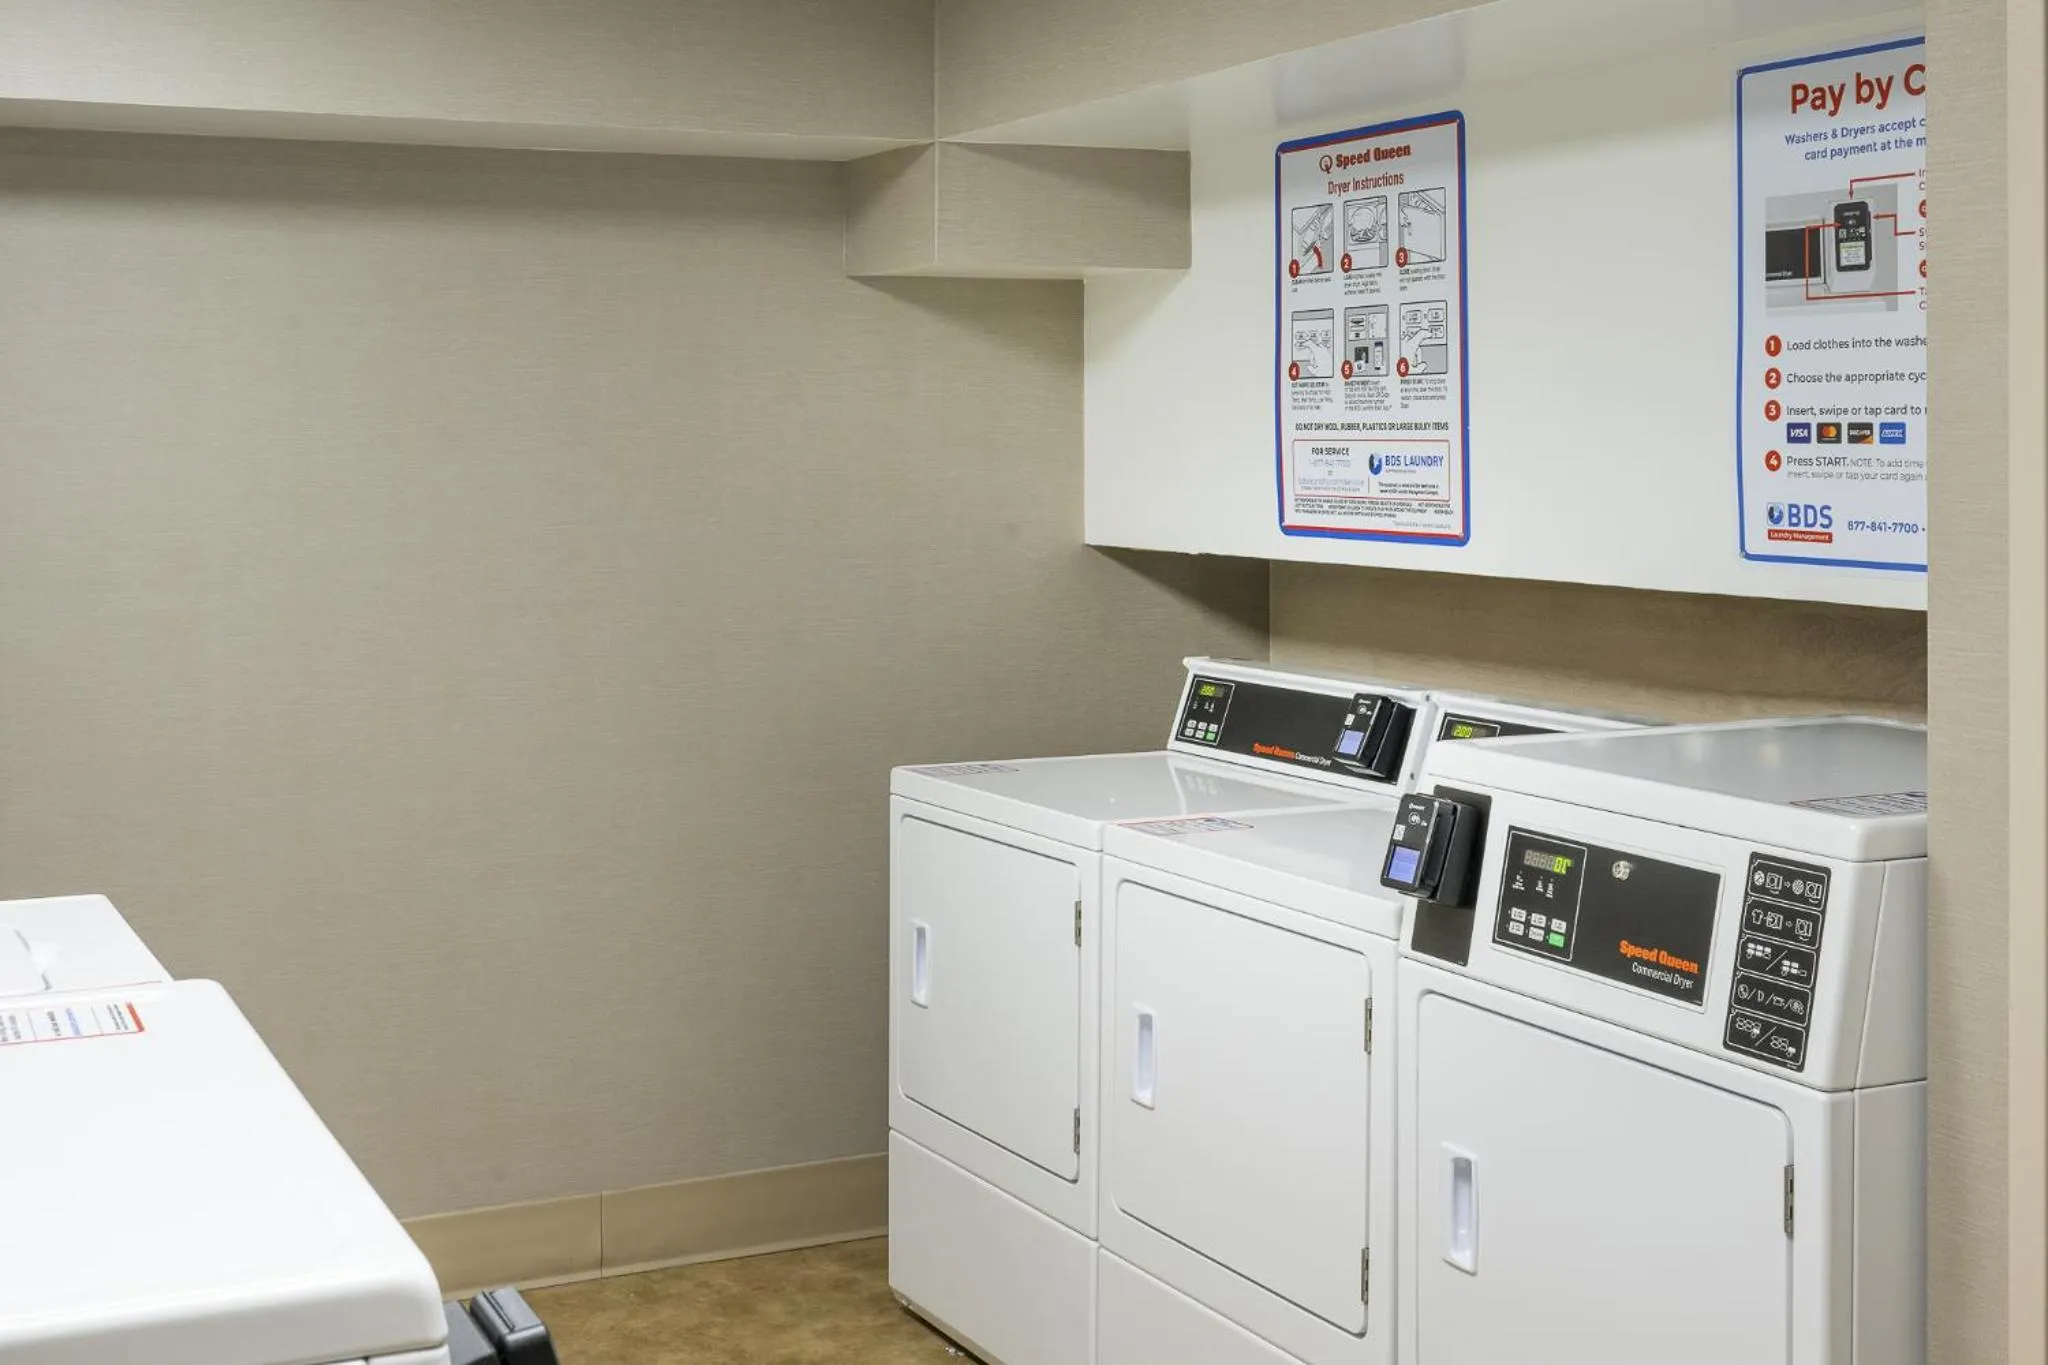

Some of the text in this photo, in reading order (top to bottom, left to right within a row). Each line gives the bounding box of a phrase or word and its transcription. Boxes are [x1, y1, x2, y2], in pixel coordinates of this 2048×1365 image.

[1791, 82, 1846, 117] Pay
[1855, 72, 1894, 110] by
[1784, 131, 1829, 146] Washers
[1830, 128, 1838, 139] &
[1841, 124, 1876, 139] Dryers
[1878, 117, 1917, 132] accept
[1804, 147, 1828, 161] card
[1830, 143, 1877, 160] payment
[1880, 140, 1892, 151] at
[1895, 136, 1913, 149] the
[1335, 149, 1371, 170] Speed
[1373, 144, 1411, 163] Queen
[1327, 172, 1405, 197] Dryer Instructions
[1787, 340, 1811, 351] Load
[1813, 338, 1850, 350] clothes
[1852, 338, 1872, 349] into
[1875, 336, 1892, 347] the
[1787, 373, 1823, 384] Choose
[1825, 372, 1842, 383] the
[1844, 370, 1906, 385] appropriate
[1787, 405, 1817, 417] Insert,
[1819, 405, 1849, 417] swipe
[1851, 407, 1861, 416] or
[1864, 406, 1882, 418] tap
[1885, 405, 1907, 416] card
[1910, 406, 1922, 415] to
[1303, 422, 1313, 431] NOT
[1314, 422, 1324, 431] DRY
[1362, 422, 1387, 431] PLASTICS
[1388, 422, 1395, 431] OR
[1396, 422, 1413, 431] LARGE
[1414, 422, 1431, 431] BULKY
[1432, 421, 1449, 431] ITEMS
[1790, 428, 1809, 438] VISA
[1311, 447, 1350, 456] FOR SERVICE
[1385, 455, 1444, 467] BDS LAUNDRY
[1787, 456, 1814, 467] Press
[1816, 456, 1850, 467] START.
[1876, 458, 1886, 468] To
[1887, 458, 1903, 468] add
[1904, 458, 1924, 468] time
[1811, 470, 1834, 481] swipe
[1835, 471, 1845, 480] or
[1846, 471, 1859, 481] tap
[1859, 472, 1878, 482] your
[1879, 471, 1898, 481] card
[1900, 472, 1923, 483] again
[1787, 503, 1833, 529] BDS
[1847, 520, 1919, 534] 877-841-7700
[1770, 531, 1830, 541] Laundry Management
[1618, 939, 1699, 974] Speed Queen
[1632, 961, 1695, 989] Commercial Dryer
